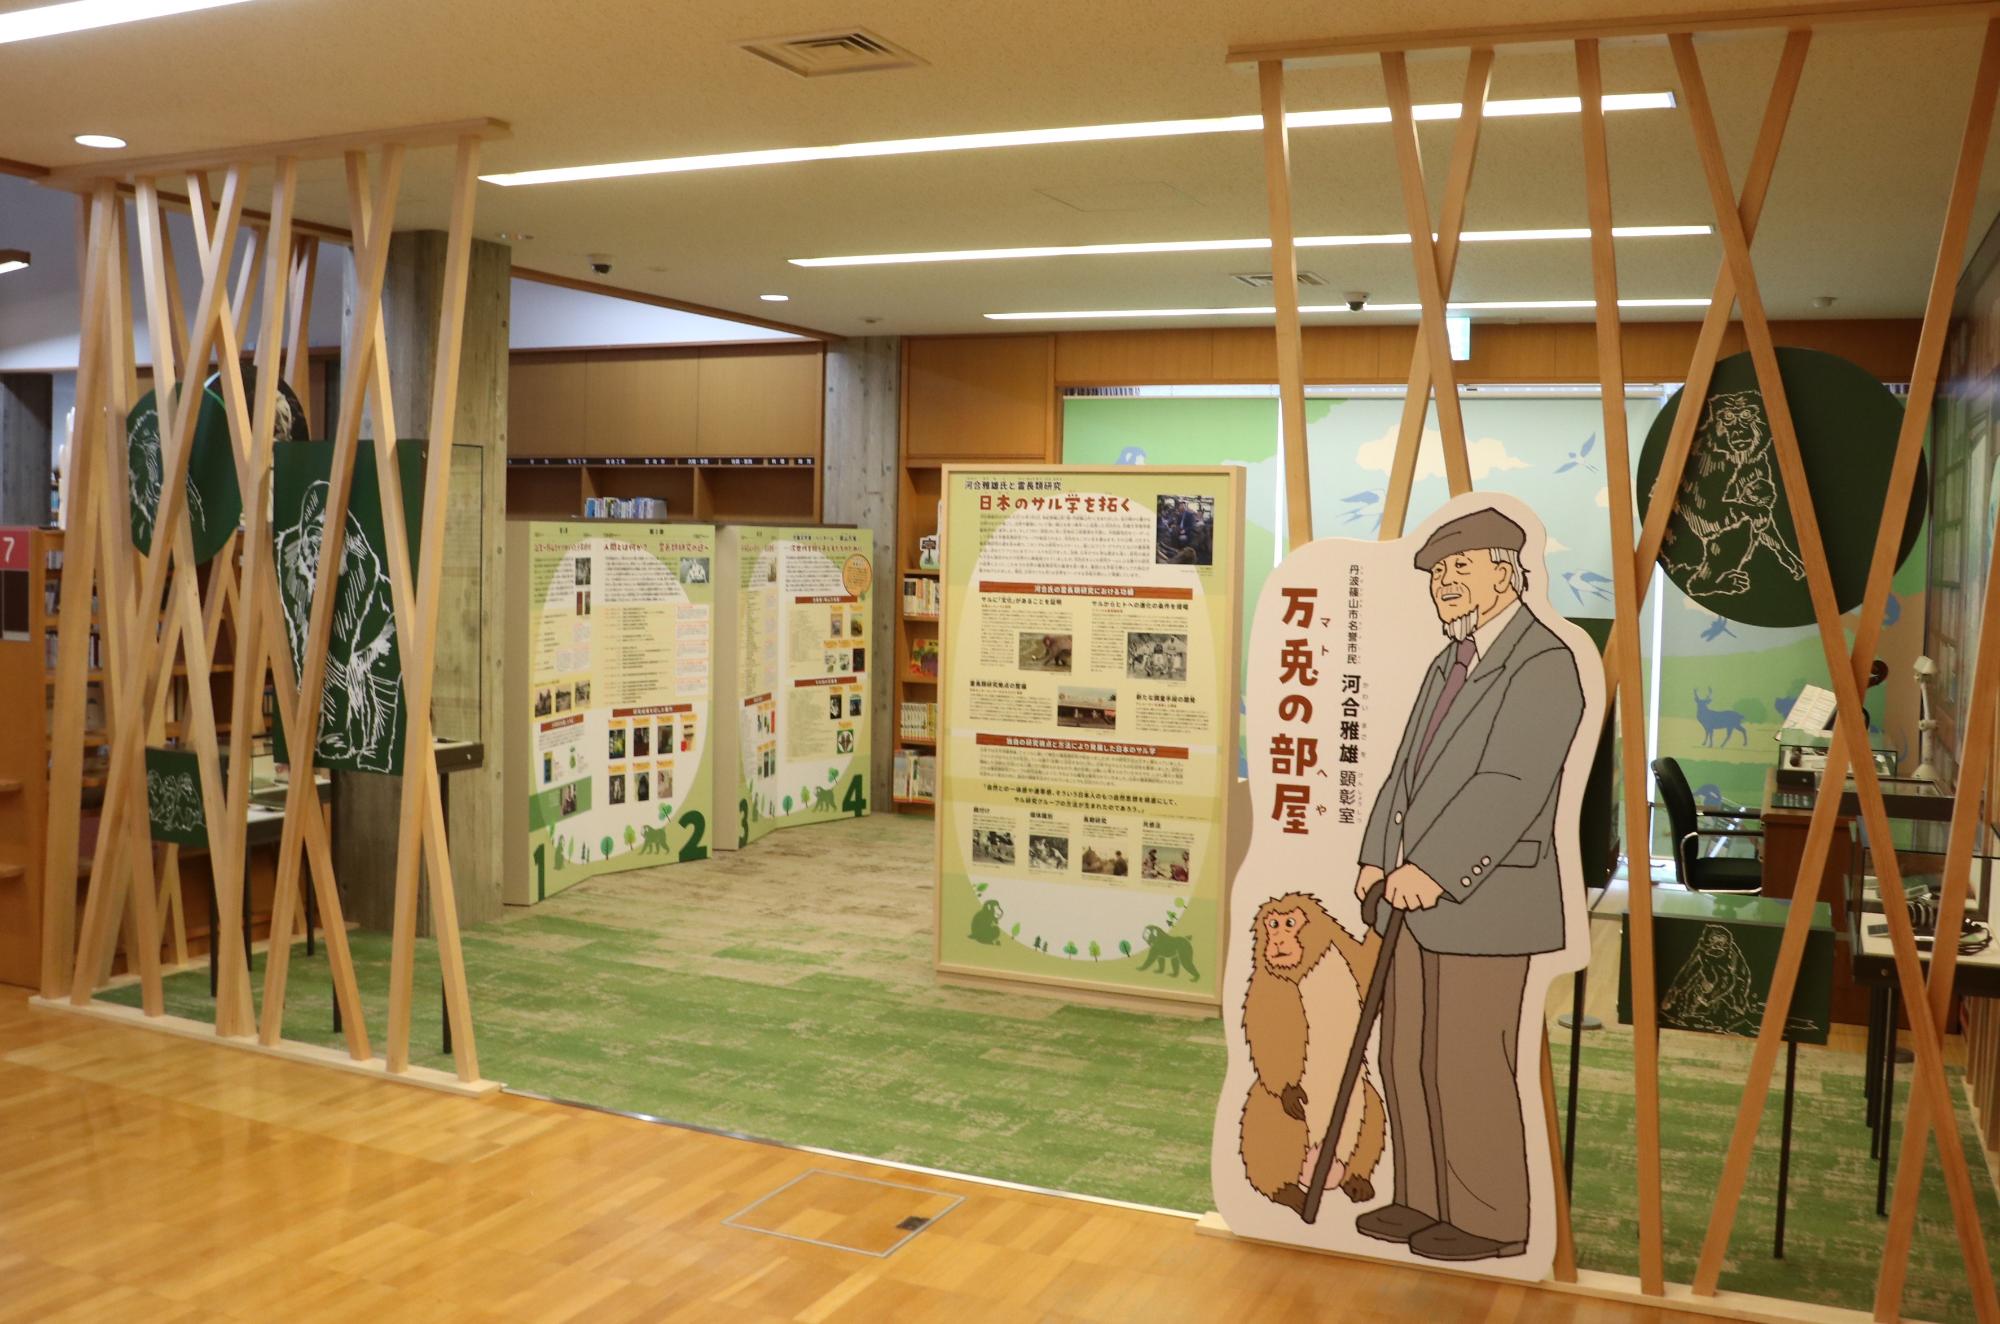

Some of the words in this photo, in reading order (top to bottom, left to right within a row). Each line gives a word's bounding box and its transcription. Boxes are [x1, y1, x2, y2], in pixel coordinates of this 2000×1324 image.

[980, 494, 1131, 513] 日本のサル学を拓く
[3, 536, 15, 562] 7
[1347, 564, 1359, 664] 丹波篠山市名誉市民
[1270, 588, 1319, 835] 万兎の部屋
[1339, 674, 1361, 764] 河合雅雄
[842, 774, 867, 817] 4
[1338, 770, 1356, 824] 顕彰室
[678, 810, 708, 863] 2
[738, 798, 749, 849] 3
[533, 843, 545, 901] 1
